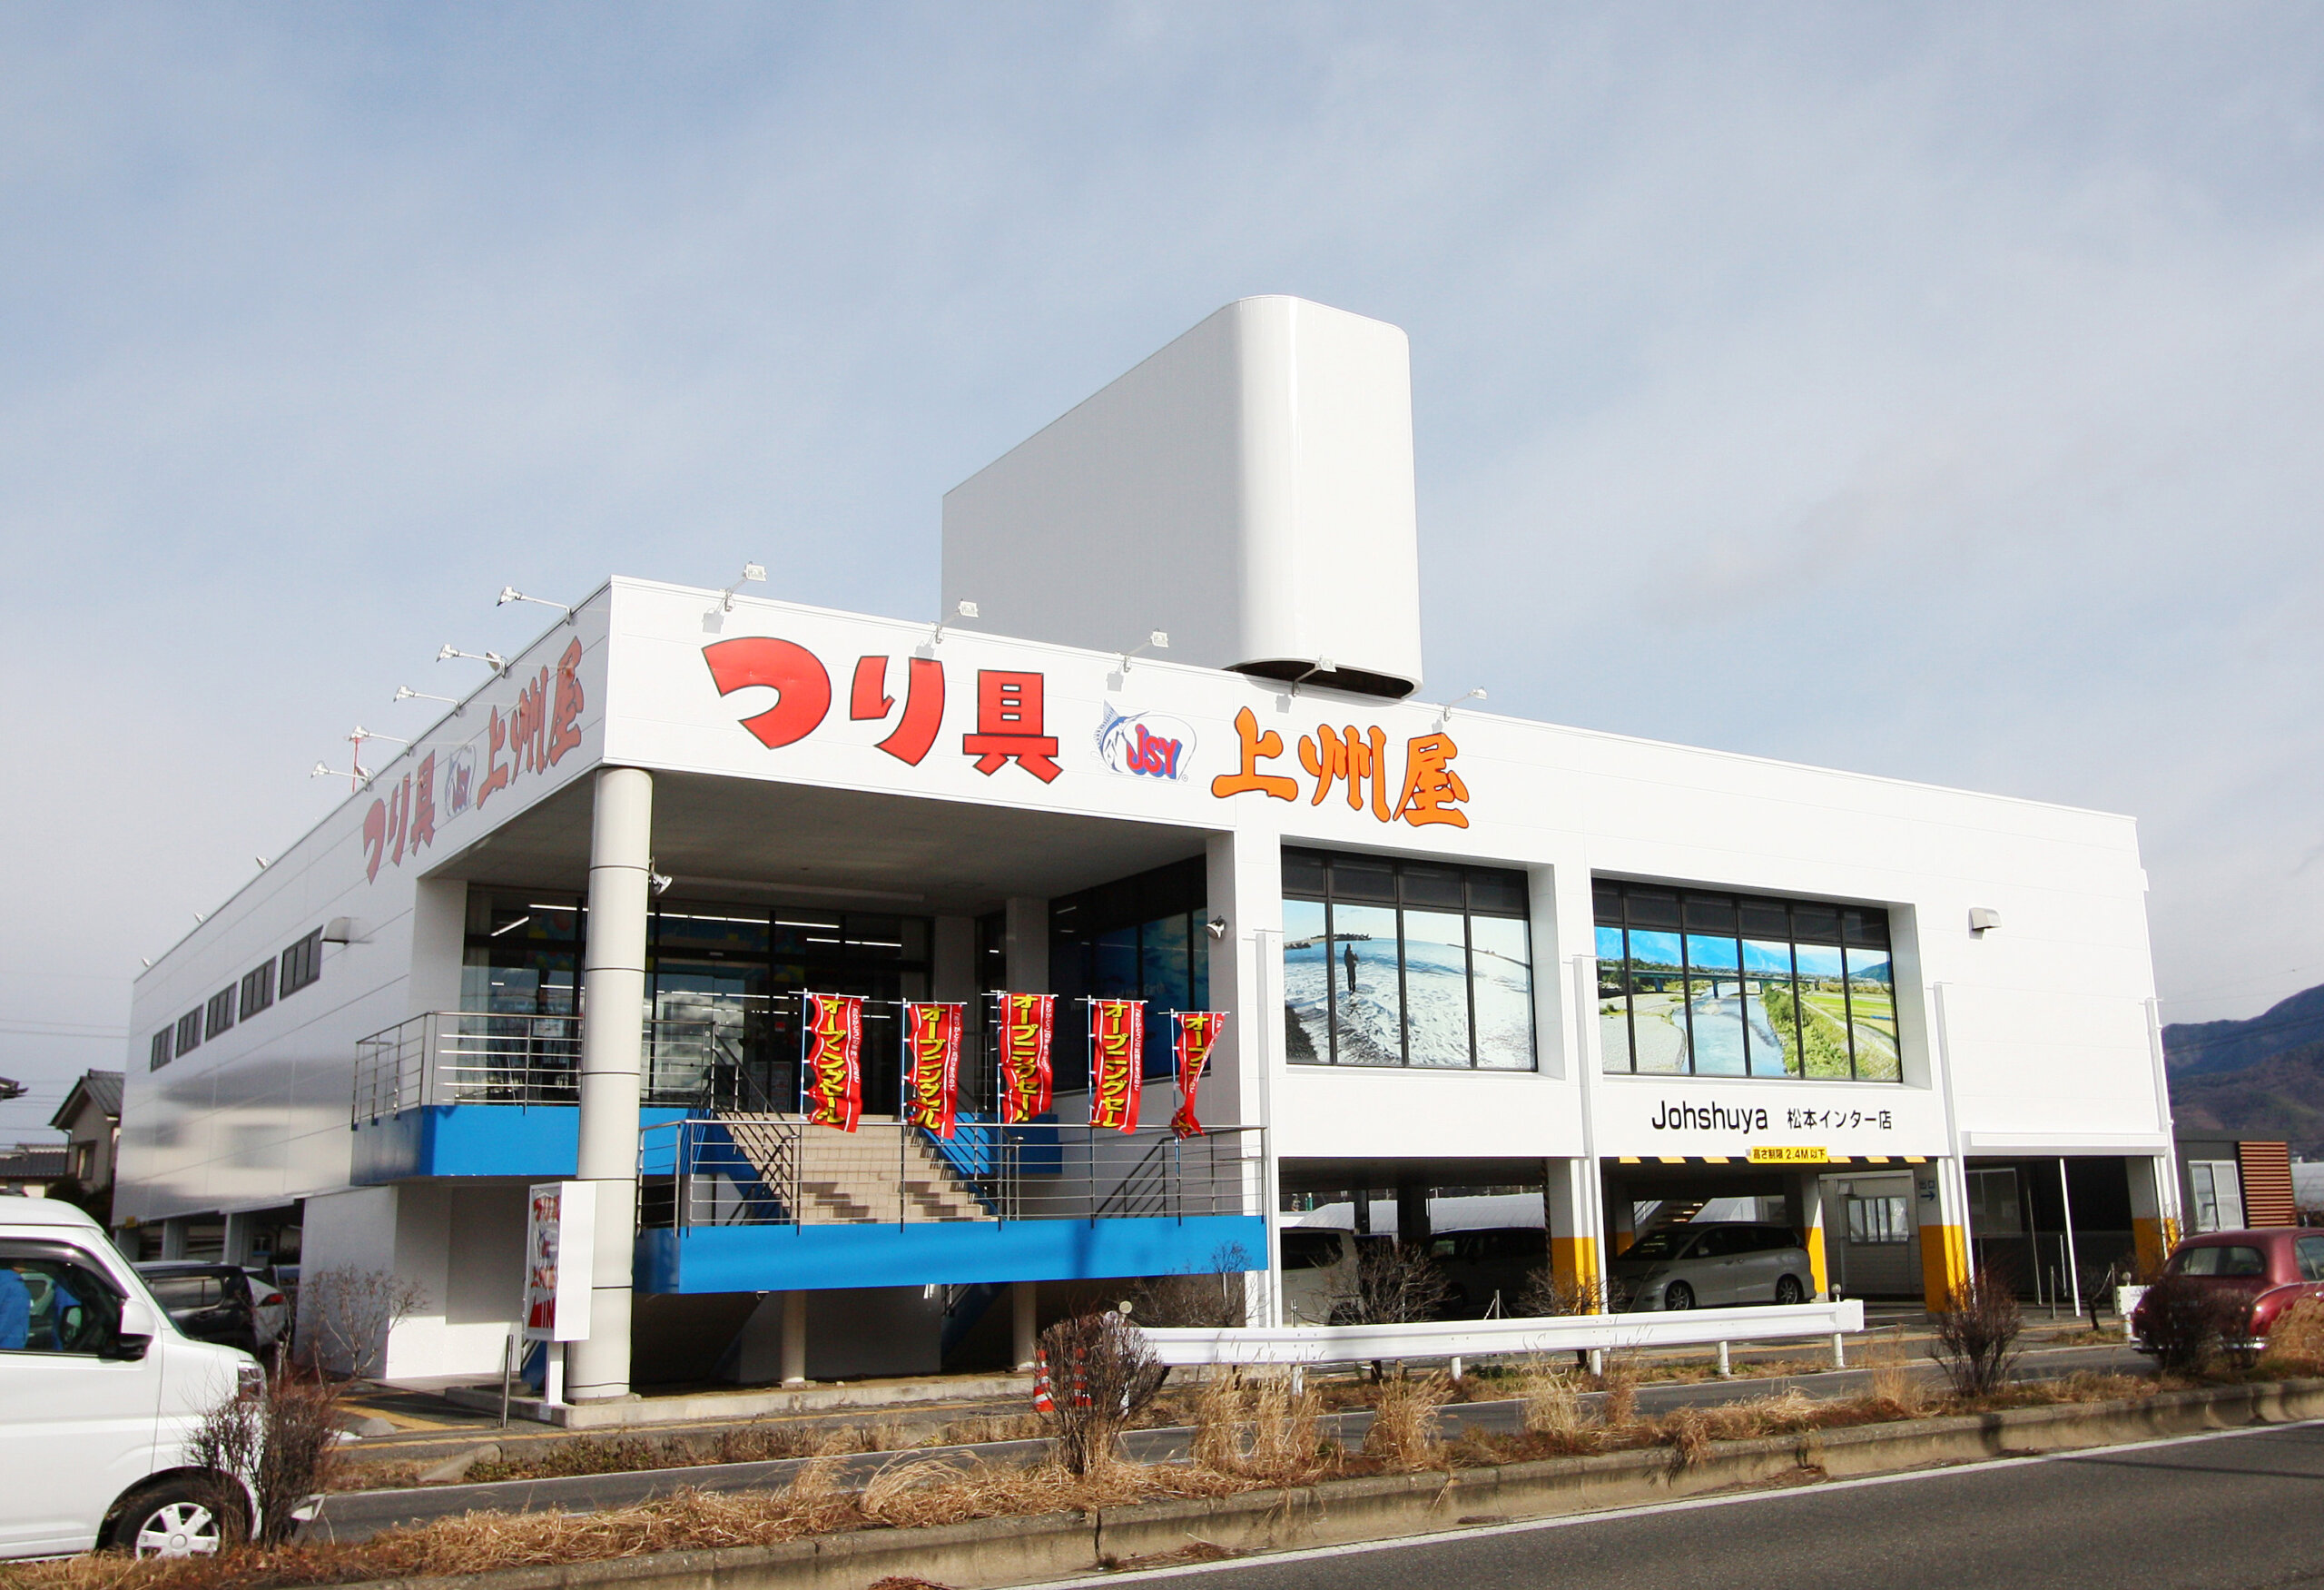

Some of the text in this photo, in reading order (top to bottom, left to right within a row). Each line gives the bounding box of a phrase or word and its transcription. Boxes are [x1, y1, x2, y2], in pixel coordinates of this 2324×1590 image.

[363, 748, 436, 886] つり具
[477, 636, 585, 811] 上州屋
[702, 636, 1470, 831] つり具 JSY 上州屋
[1651, 1101, 1893, 1134] Johshuya 松本インター店
